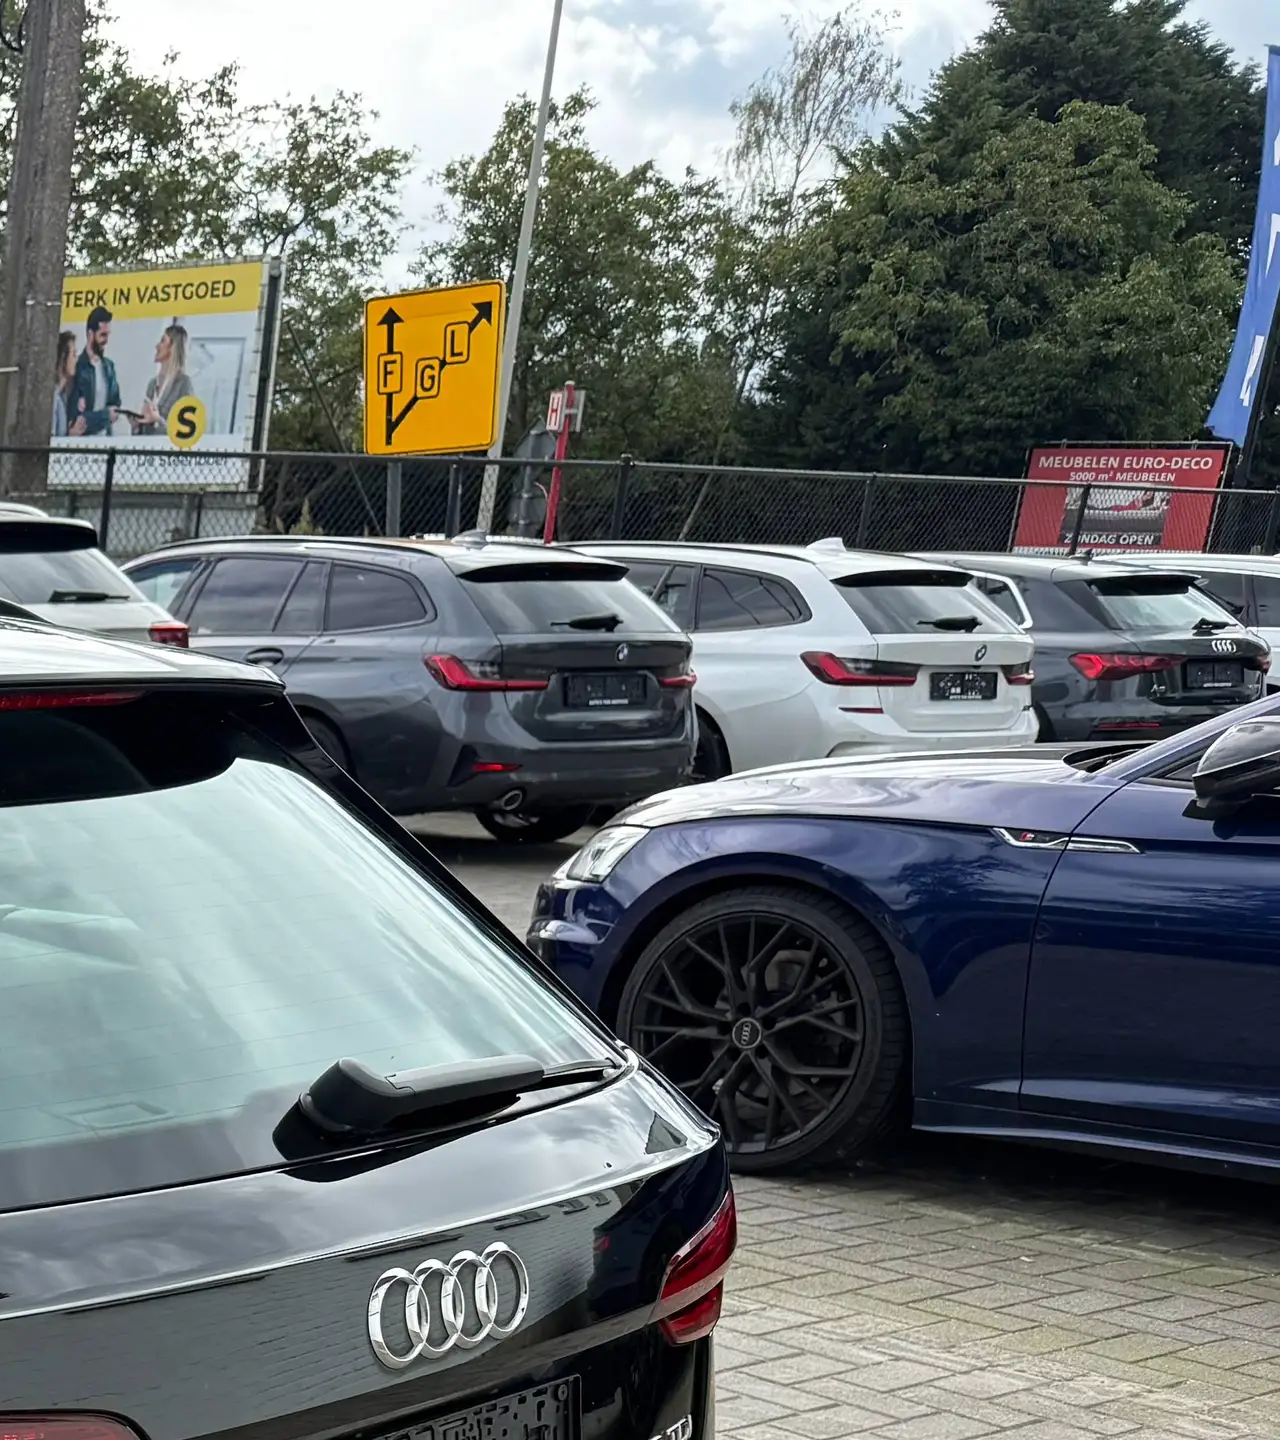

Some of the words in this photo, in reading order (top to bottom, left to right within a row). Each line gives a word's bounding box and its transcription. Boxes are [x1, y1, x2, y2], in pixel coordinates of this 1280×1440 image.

[63, 288, 109, 308] TERK
[112, 286, 131, 305] IN
[136, 279, 236, 304] VASTGOED
[450, 330, 463, 357] L
[383, 360, 397, 388] F
[420, 364, 435, 392] G
[175, 405, 198, 440] S
[1039, 455, 1119, 469] MEUBELEN
[1123, 457, 1213, 470] EURO-DECO
[1069, 471, 1095, 482] 5000
[1116, 472, 1176, 482] MEUBELEN
[1064, 533, 1117, 545] ZNDAG
[1120, 534, 1154, 545] OPEN
